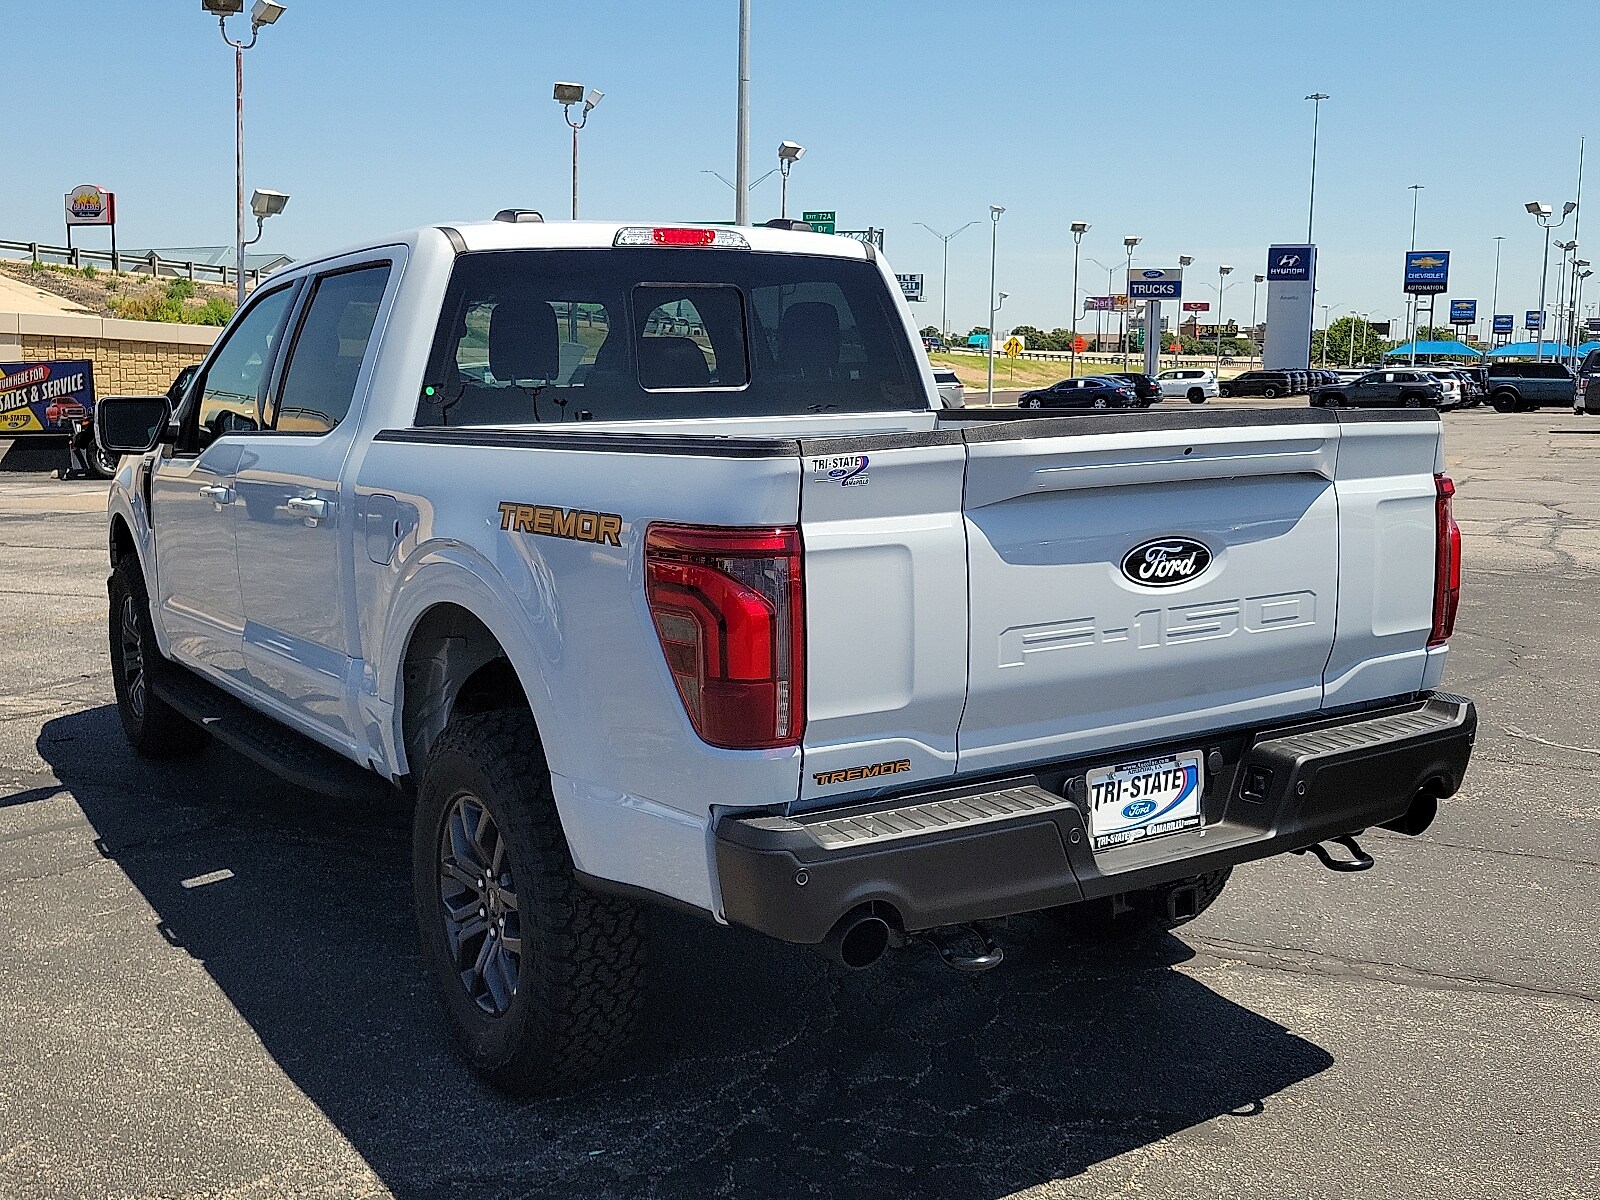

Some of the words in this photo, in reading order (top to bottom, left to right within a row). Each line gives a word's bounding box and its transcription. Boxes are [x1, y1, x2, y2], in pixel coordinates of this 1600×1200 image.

[817, 225, 828, 233] Dr
[1270, 267, 1305, 275] HYUNDAI
[901, 282, 916, 290] 211
[1131, 284, 1175, 295] TRUCKS
[1093, 298, 1113, 309] park
[1207, 325, 1213, 334] 5
[13, 371, 29, 386] HERE
[29, 367, 44, 381] FOR
[0, 388, 28, 412] SALES
[31, 385, 39, 403] &
[41, 373, 84, 400] SERVICE
[812, 456, 860, 473] TRI-STATE
[498, 501, 623, 547] TREMOR
[1139, 545, 1197, 579] Ford
[998, 589, 1317, 668] F-150
[813, 759, 911, 785] TREMOR
[1091, 769, 1183, 812] TRI-STATE
[1128, 801, 1151, 816] Ford
[1150, 820, 1184, 836] AMARILLO
[1096, 831, 1131, 848] TRI-STATE
